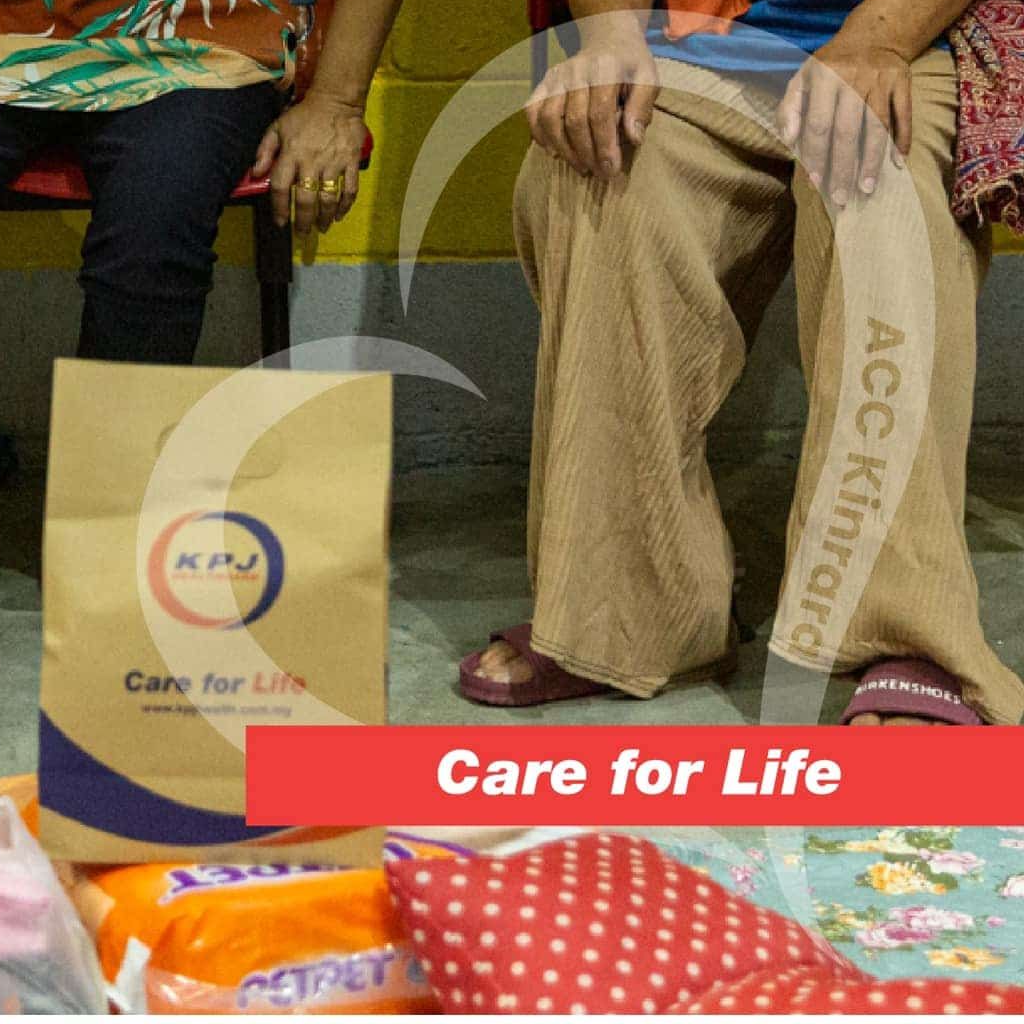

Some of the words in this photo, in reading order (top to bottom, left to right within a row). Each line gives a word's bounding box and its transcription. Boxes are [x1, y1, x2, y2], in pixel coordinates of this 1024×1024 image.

[175, 552, 259, 571] KPJ
[124, 670, 191, 694] Care
[202, 673, 246, 694] for
[252, 672, 307, 695] Life
